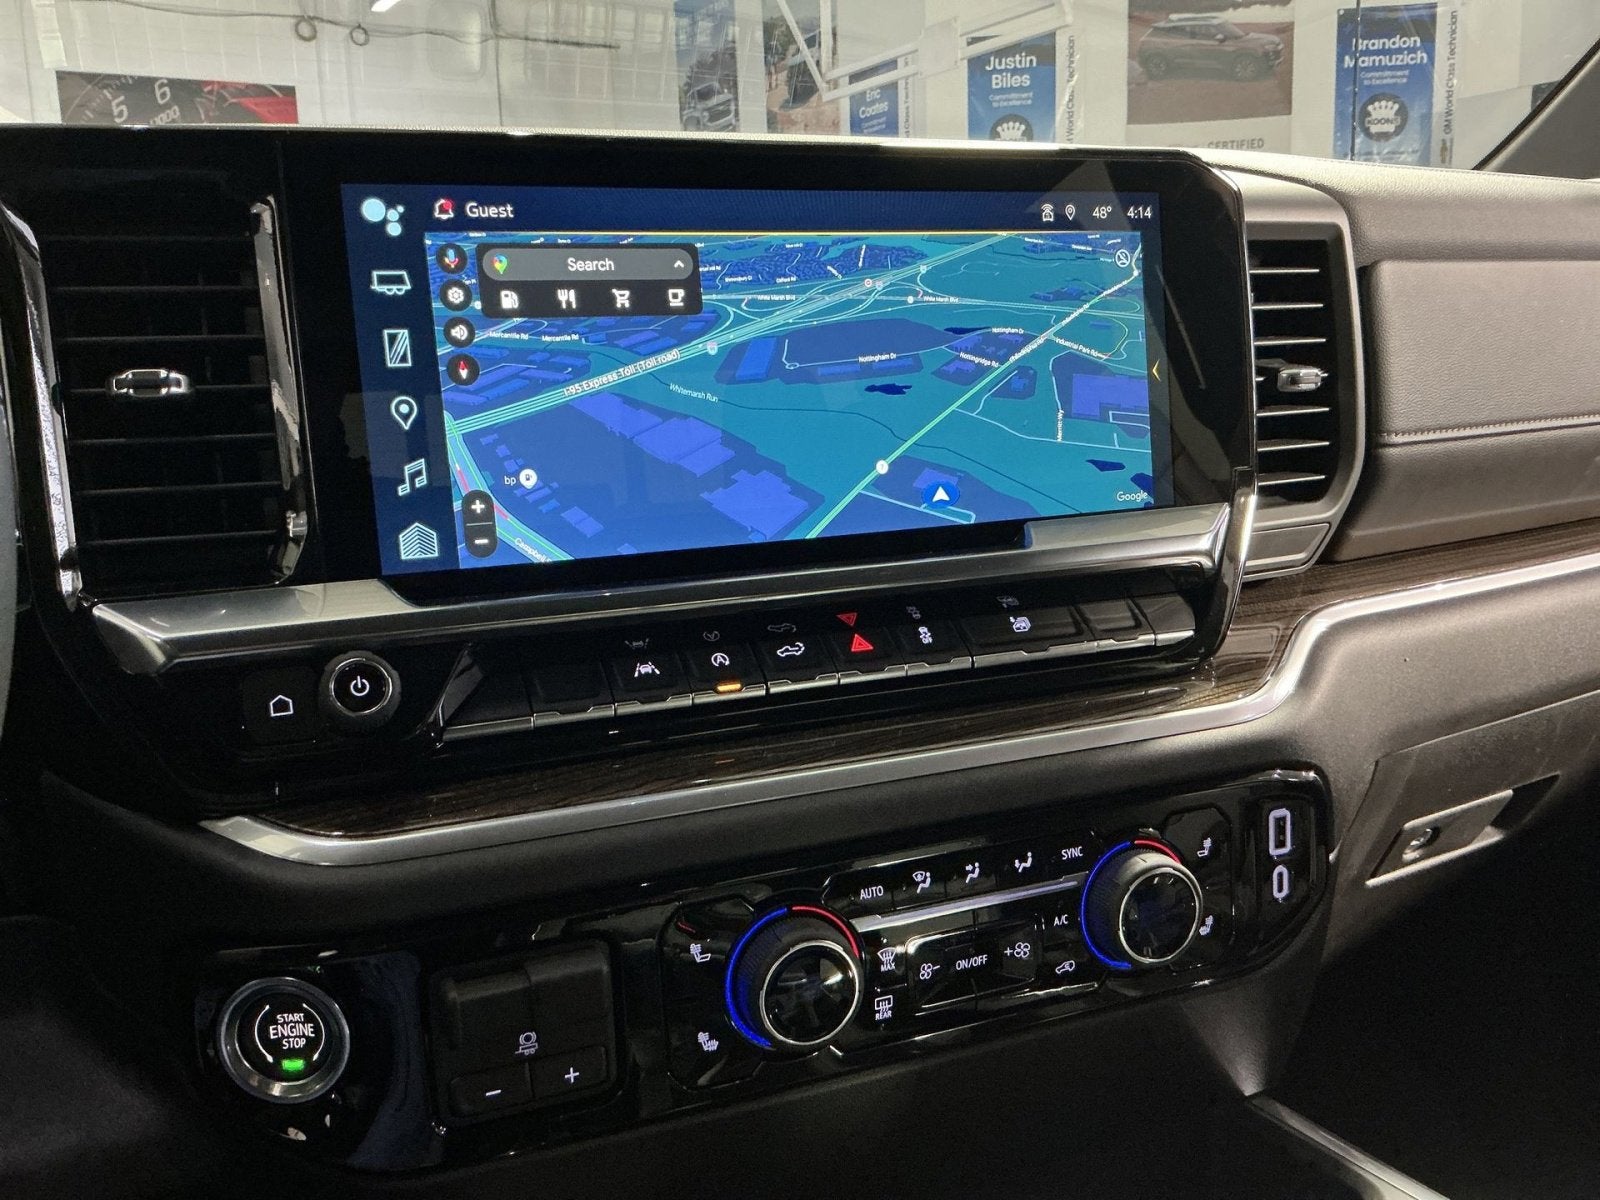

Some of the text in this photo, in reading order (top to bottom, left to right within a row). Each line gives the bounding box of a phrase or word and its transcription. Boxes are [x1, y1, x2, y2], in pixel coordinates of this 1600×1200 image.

[1447, 10, 1458, 61] Technician
[985, 52, 1037, 70] Justin
[1344, 51, 1427, 68] Mamuzich
[991, 72, 1031, 89] Biles
[1446, 62, 1455, 89] Class
[154, 79, 171, 104] 6
[866, 89, 881, 102] Eric
[110, 95, 129, 123] 5
[859, 102, 889, 119] Coates
[1444, 90, 1454, 118] World
[1443, 119, 1453, 135] GM
[1208, 138, 1265, 149] CERTIFIED
[466, 203, 514, 218] Guest
[1092, 205, 1113, 219] 48°
[1127, 205, 1152, 219] 4:14
[567, 257, 615, 271] Search
[489, 331, 529, 340] Mercantile Rd
[541, 334, 571, 342] Mercantile
[858, 352, 897, 363] Nottingham Dr
[584, 373, 618, 390] Express
[620, 365, 636, 378] Toll
[636, 358, 657, 373] (Toll
[657, 348, 681, 365] road)
[670, 382, 719, 403] Whitemarsh Run
[504, 475, 517, 486] bp
[1116, 489, 1149, 502] Google
[1061, 846, 1083, 861] SYNC
[860, 885, 884, 900] AUTO
[1053, 914, 1069, 927] A/C
[881, 962, 896, 972] MAX
[955, 954, 988, 970] ON/OFF
[277, 1013, 304, 1023] START
[875, 1010, 892, 1020] REAR
[269, 1024, 315, 1038] ENGINE
[282, 1039, 306, 1049] STOP
